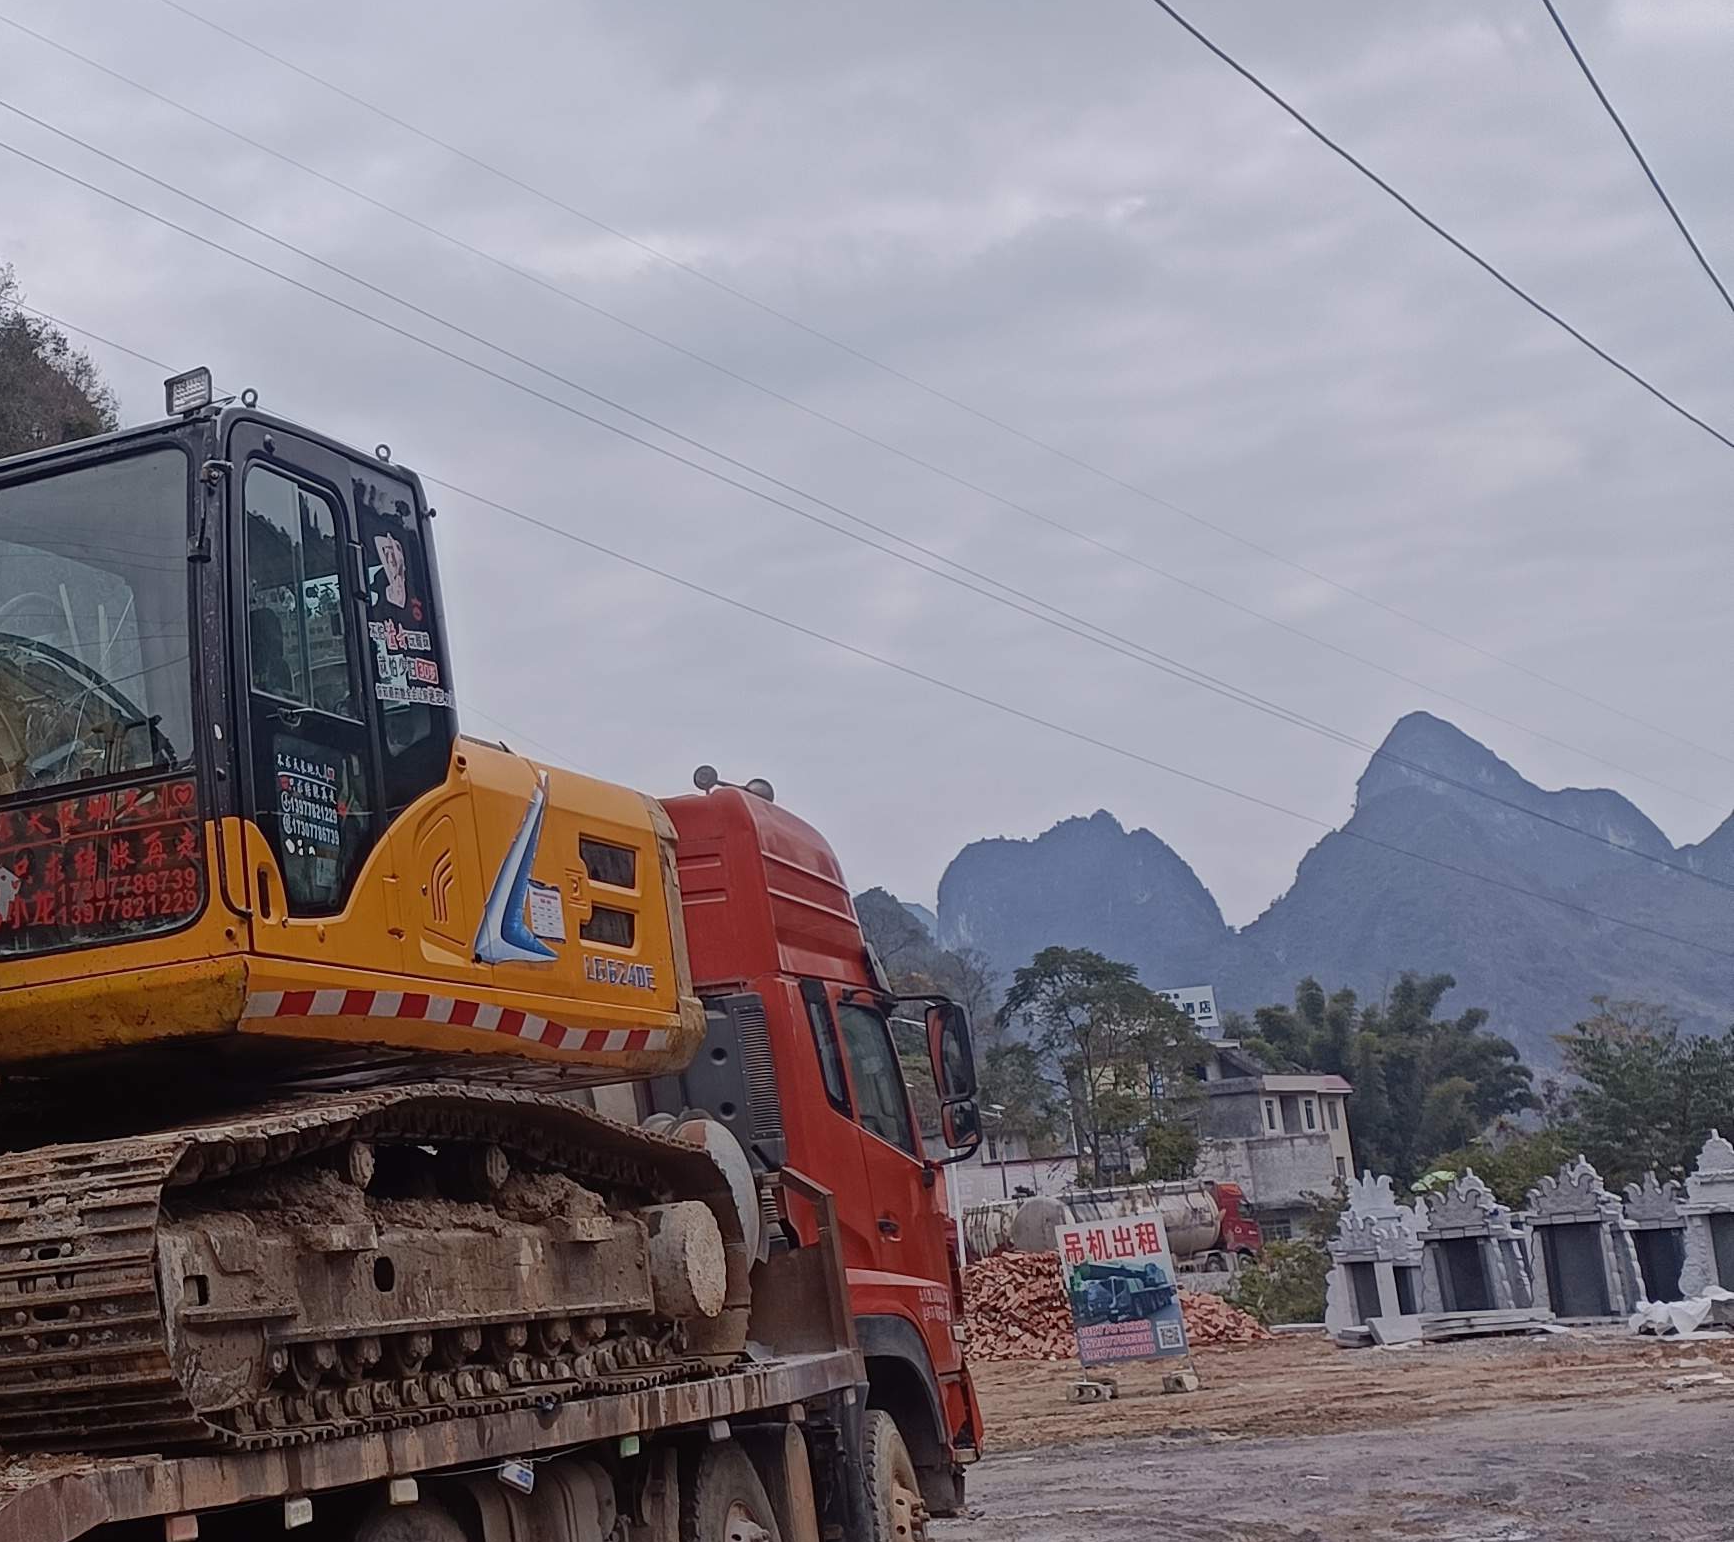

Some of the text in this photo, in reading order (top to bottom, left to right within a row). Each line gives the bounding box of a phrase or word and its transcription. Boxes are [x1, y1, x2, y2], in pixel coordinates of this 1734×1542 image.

[57, 867, 197, 904] 17307786739
[59, 892, 198, 926] 13977821229
[1063, 1222, 1163, 1265] 吊机出租
